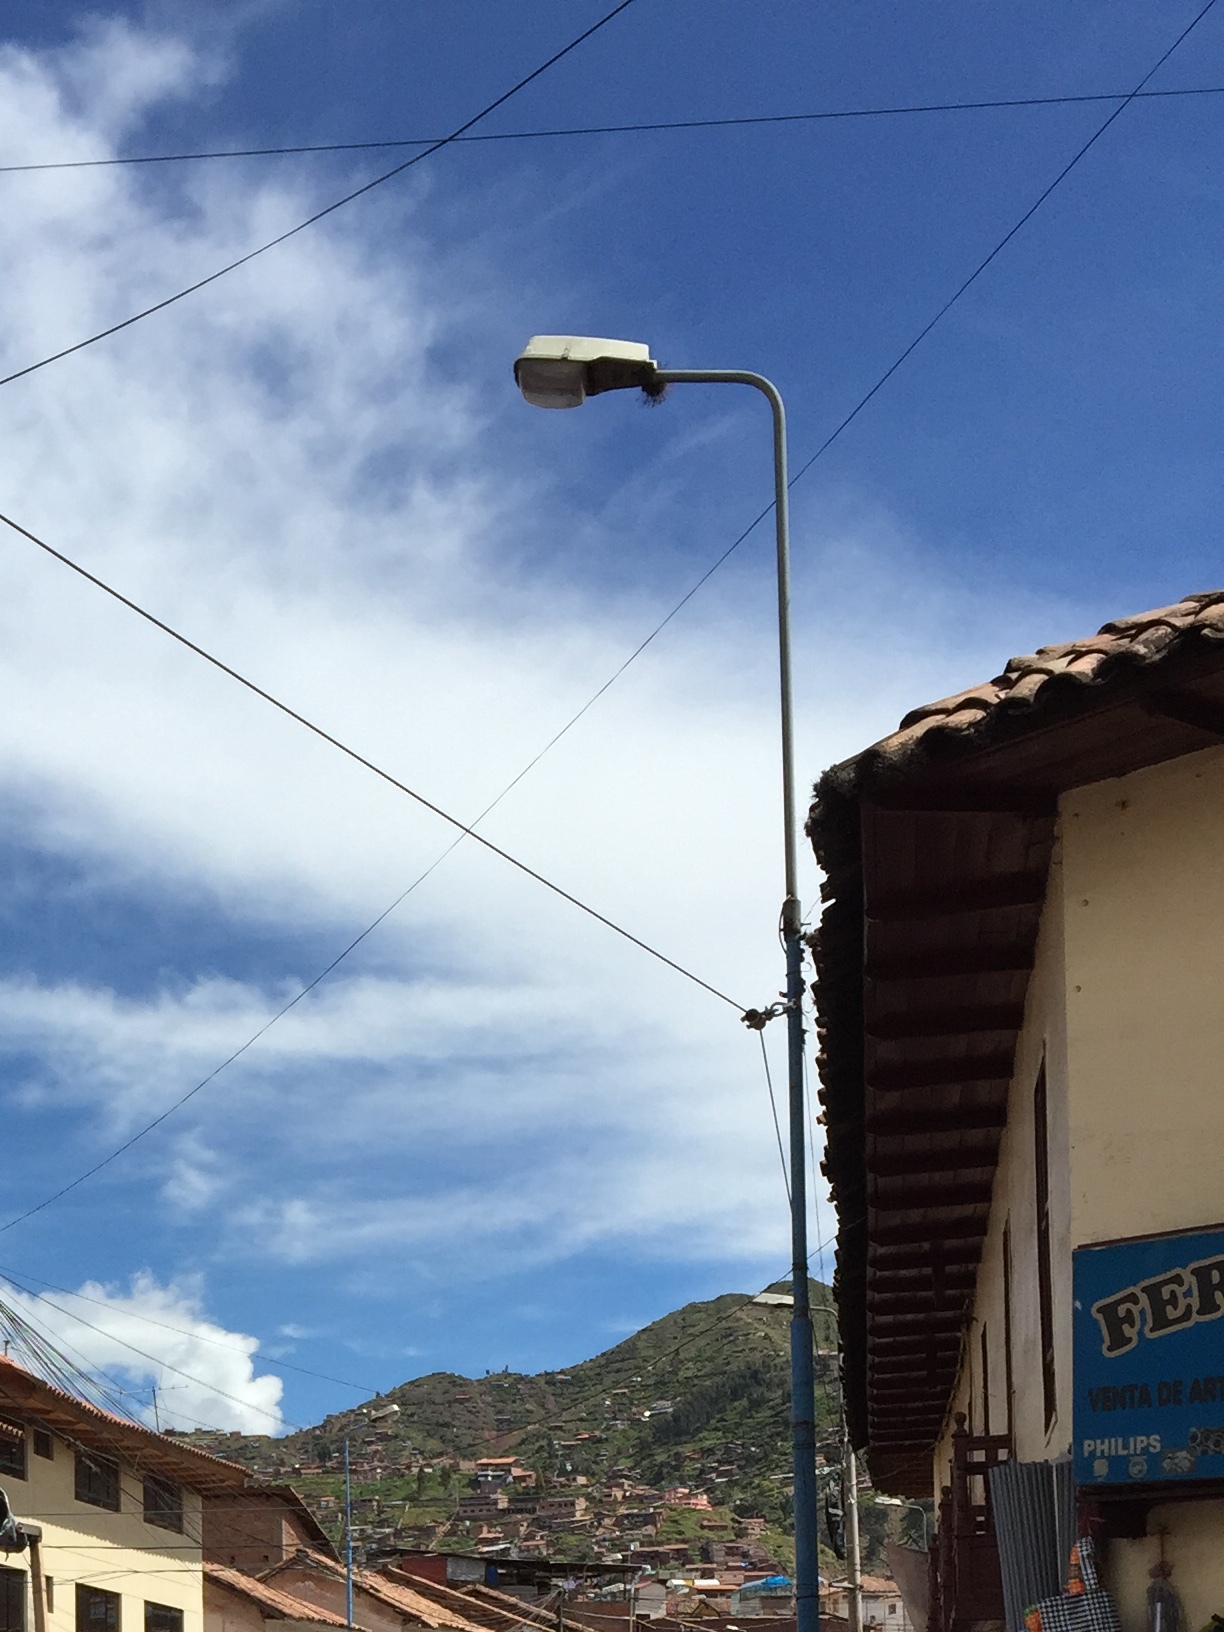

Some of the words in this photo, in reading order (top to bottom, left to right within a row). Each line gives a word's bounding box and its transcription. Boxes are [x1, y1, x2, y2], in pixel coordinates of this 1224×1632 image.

[1088, 1383, 1152, 1412] VENTA
[1158, 1380, 1184, 1407] DE
[1083, 1434, 1162, 1458] PHILIPS
